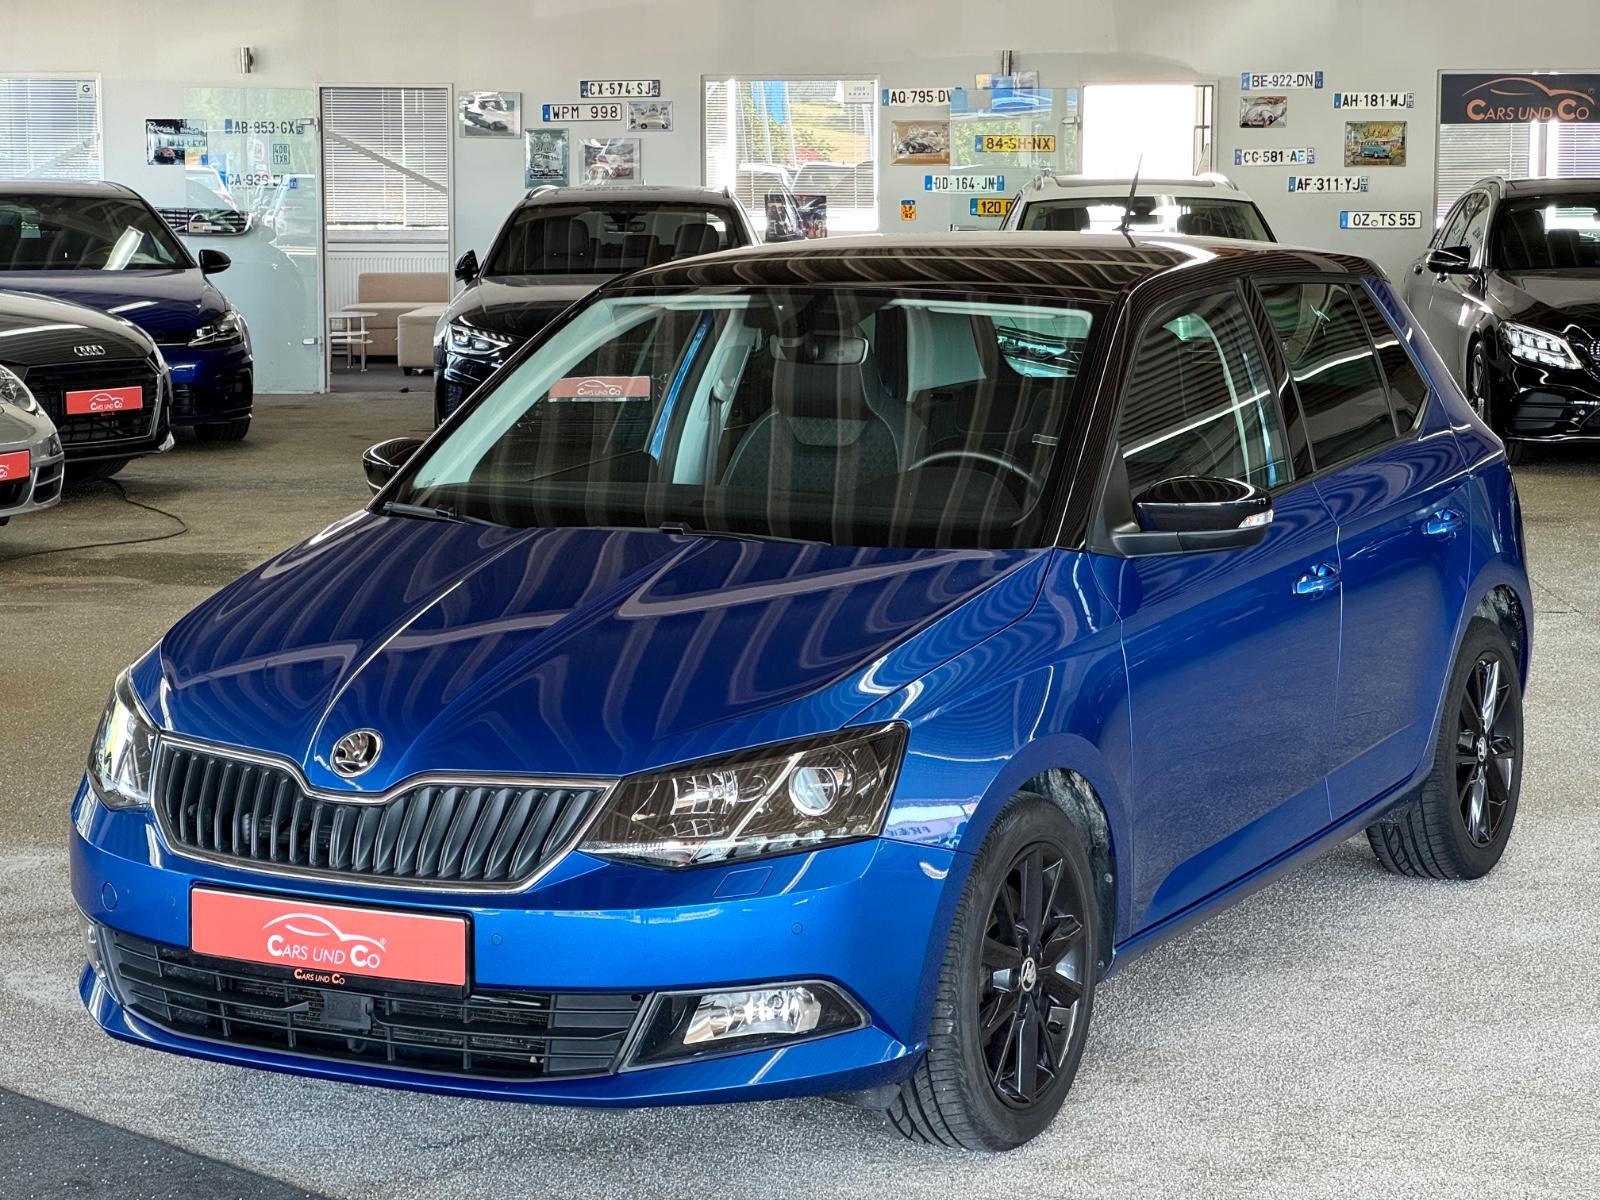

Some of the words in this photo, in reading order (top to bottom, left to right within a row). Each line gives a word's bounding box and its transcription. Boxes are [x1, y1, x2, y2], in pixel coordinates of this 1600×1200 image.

[1252, 74, 1313, 87] BE-922-DN
[589, 82, 651, 95] CX-574-SJ
[1342, 94, 1406, 107] AH-181-WJ
[552, 106, 579, 119] WPM
[591, 105, 618, 118] 998
[1518, 106, 1552, 120] UND
[1296, 178, 1360, 191] AF-311-YJ
[981, 201, 1001, 213] 120
[1380, 213, 1396, 226] TS
[1399, 213, 1416, 226] 55
[311, 948, 346, 965] UND
